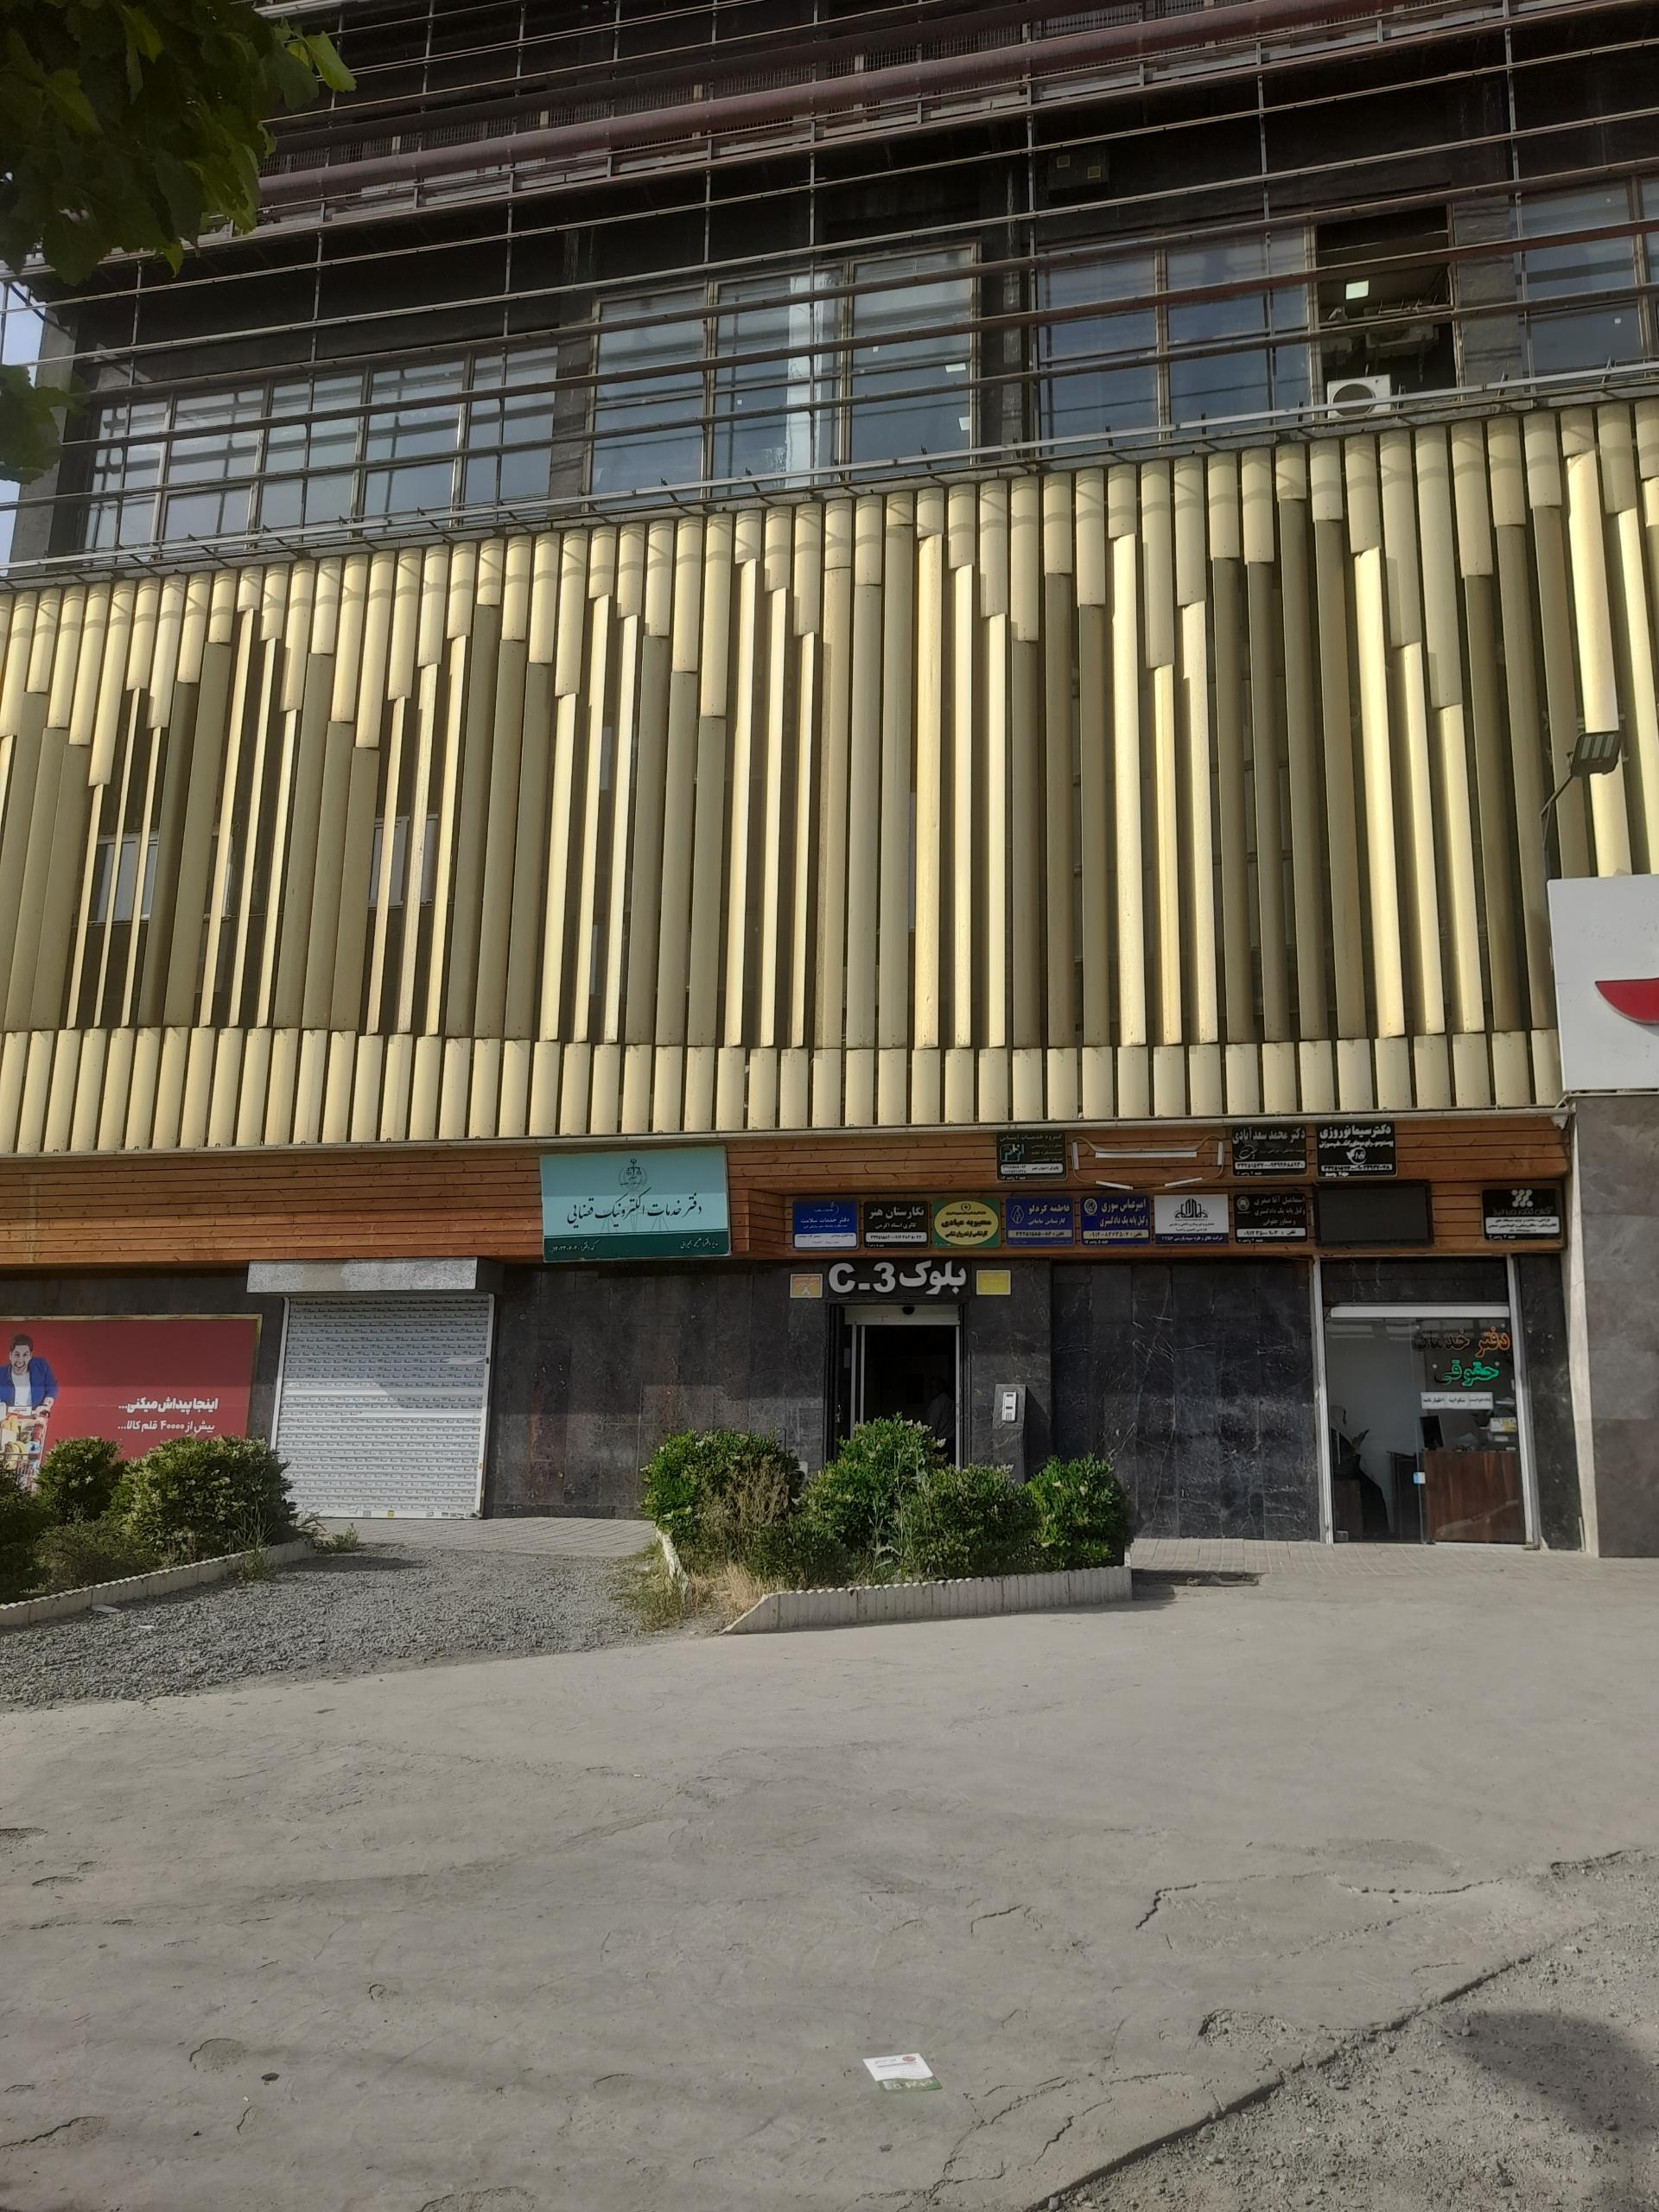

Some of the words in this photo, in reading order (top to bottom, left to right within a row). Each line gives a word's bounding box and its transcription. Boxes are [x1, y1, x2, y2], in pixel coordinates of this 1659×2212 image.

[1268, 1130, 1287, 1141] محمد
[1289, 1127, 1306, 1143] دکتر
[1319, 1125, 1351, 1139] نوروزی
[1351, 1124, 1371, 1138] سیما
[1370, 1123, 1391, 1138] دکتر
[594, 1186, 652, 1228] الکترونیک
[647, 1199, 682, 1217] خدمات
[681, 1192, 702, 1217] دفتر
[1049, 1204, 1071, 1212] فاطمه
[868, 1208, 883, 1219] هنر
[886, 1206, 925, 1219] نگارستان
[1254, 1208, 1276, 1217] دادگستری
[941, 1218, 964, 1228] عبادی
[965, 1219, 992, 1228] محبوبه
[1100, 1216, 1121, 1228] دادگستری
[1122, 1215, 1128, 1224] یک
[1128, 1215, 1137, 1226] پایه
[1137, 1215, 1148, 1227] وکیل
[899, 1261, 967, 1295] بلوک
[1475, 1326, 1510, 1357] دفتر
[1434, 1358, 1500, 1387] حقوقی
[157, 1396, 193, 1414] پیداش
[193, 1397, 219, 1413] اینجا
[141, 1420, 158, 1433] قلم
[160, 1420, 185, 1430] ۴۰۰۰۰
[185, 1421, 193, 1433] از
[194, 1420, 215, 1433] بیش
